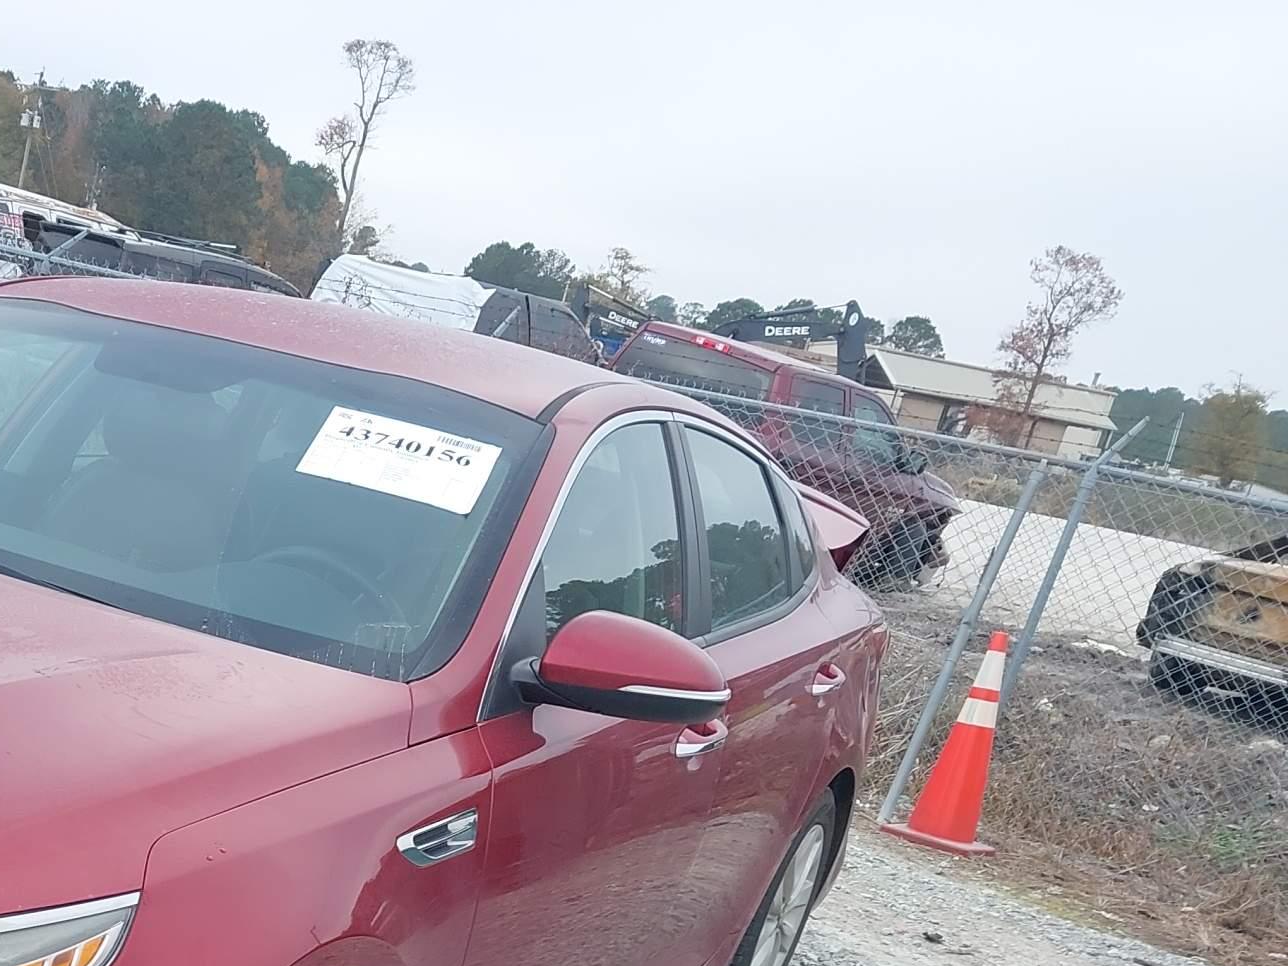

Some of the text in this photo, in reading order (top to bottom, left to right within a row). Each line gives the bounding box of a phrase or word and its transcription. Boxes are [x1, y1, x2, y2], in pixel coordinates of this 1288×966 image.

[608, 311, 639, 329] DEERE
[764, 325, 810, 337] DEERE
[338, 426, 472, 468] 43740156
